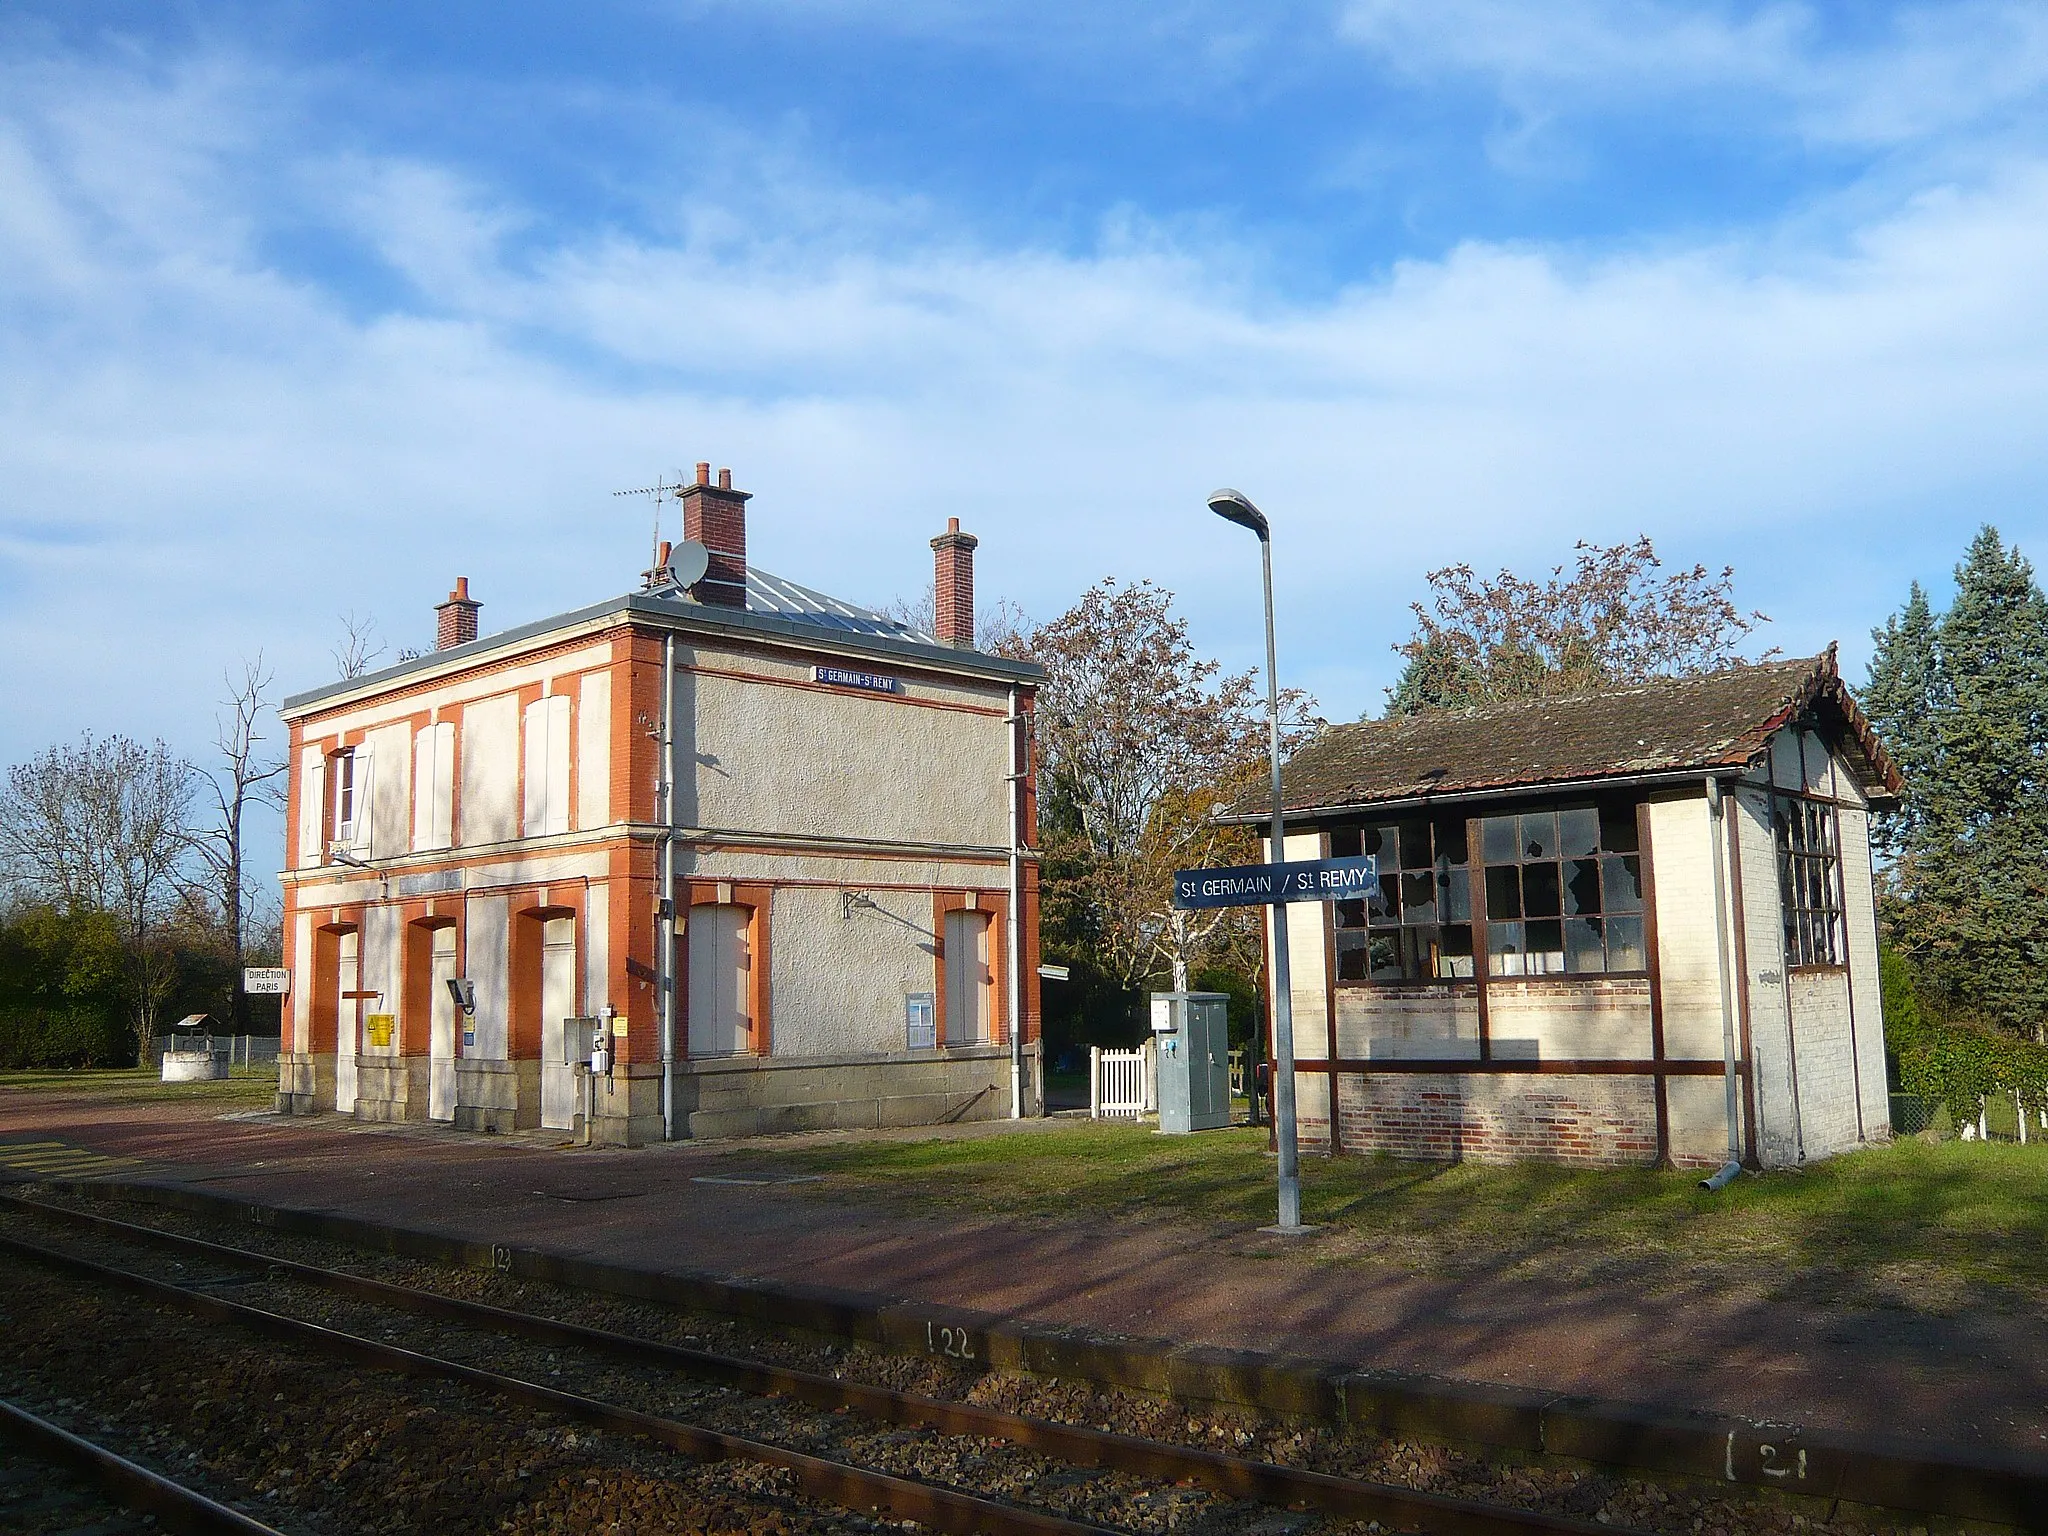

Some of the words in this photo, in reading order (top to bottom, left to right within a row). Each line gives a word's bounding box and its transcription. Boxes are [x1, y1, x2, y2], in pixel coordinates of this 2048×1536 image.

[1181, 882, 1197, 898] St
[1202, 876, 1271, 897] GERMAIN
[1281, 874, 1290, 893] /
[1297, 872, 1314, 890] St
[1320, 868, 1367, 888] REMY
[249, 970, 286, 979] DIRECTION
[256, 982, 279, 991] PARIS
[928, 1321, 975, 1359] 122
[1725, 1430, 1807, 1481] 121
